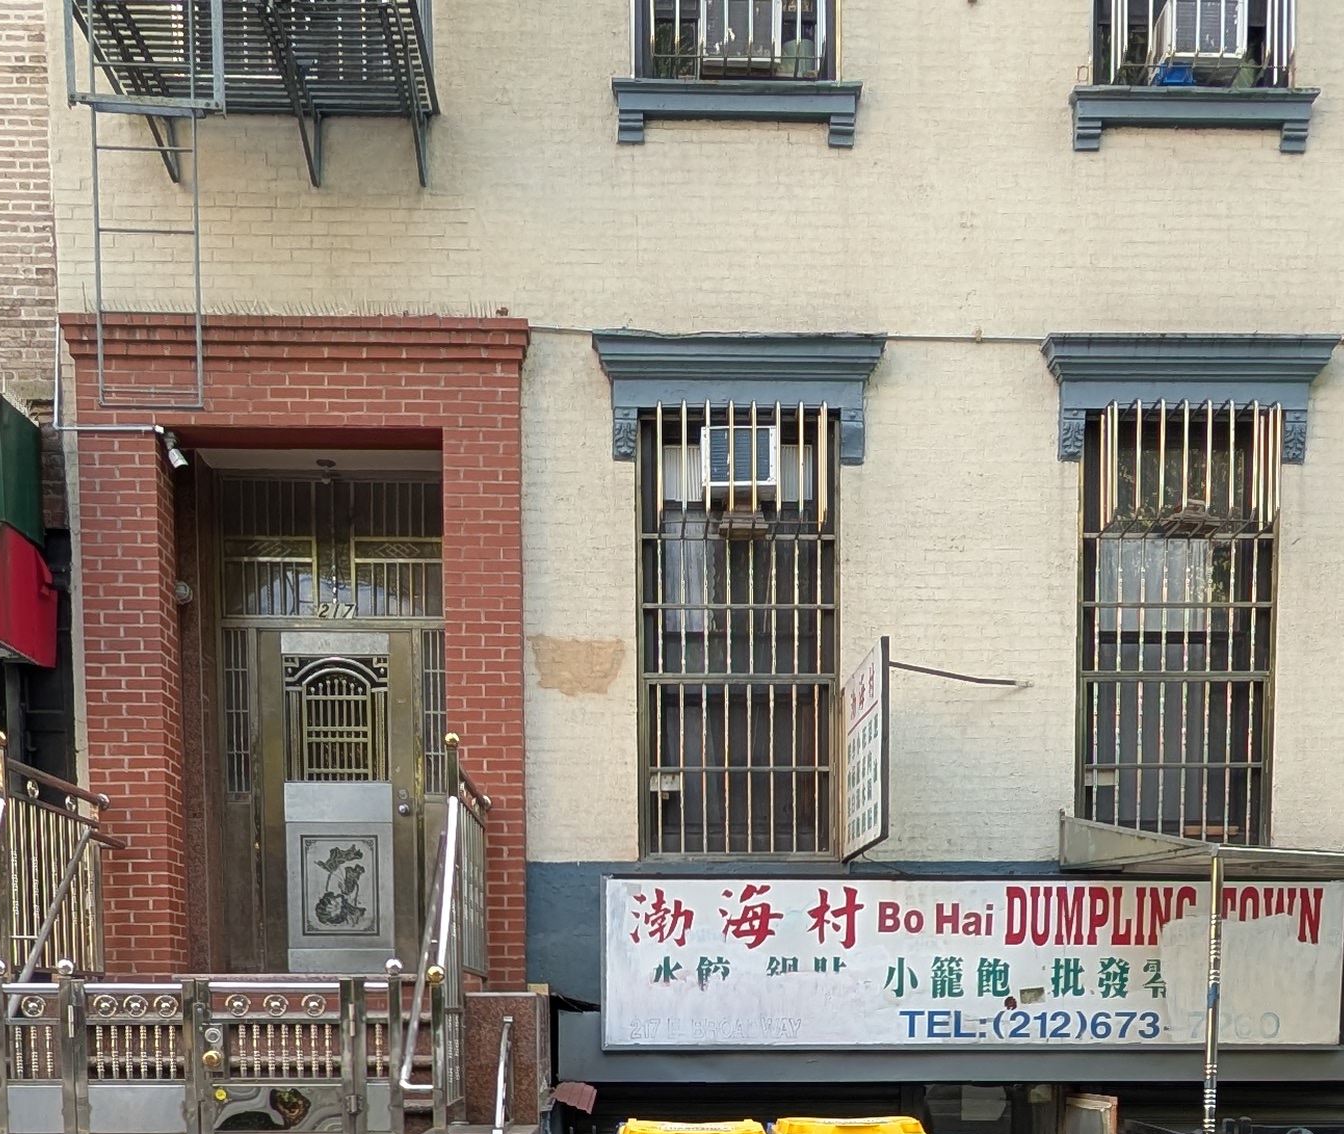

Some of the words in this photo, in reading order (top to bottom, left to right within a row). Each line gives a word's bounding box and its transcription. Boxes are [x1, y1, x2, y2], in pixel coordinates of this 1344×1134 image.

[318, 603, 355, 618] 217
[629, 883, 865, 950] 渤海村
[877, 900, 925, 934] Bo
[935, 902, 995, 937] Hai
